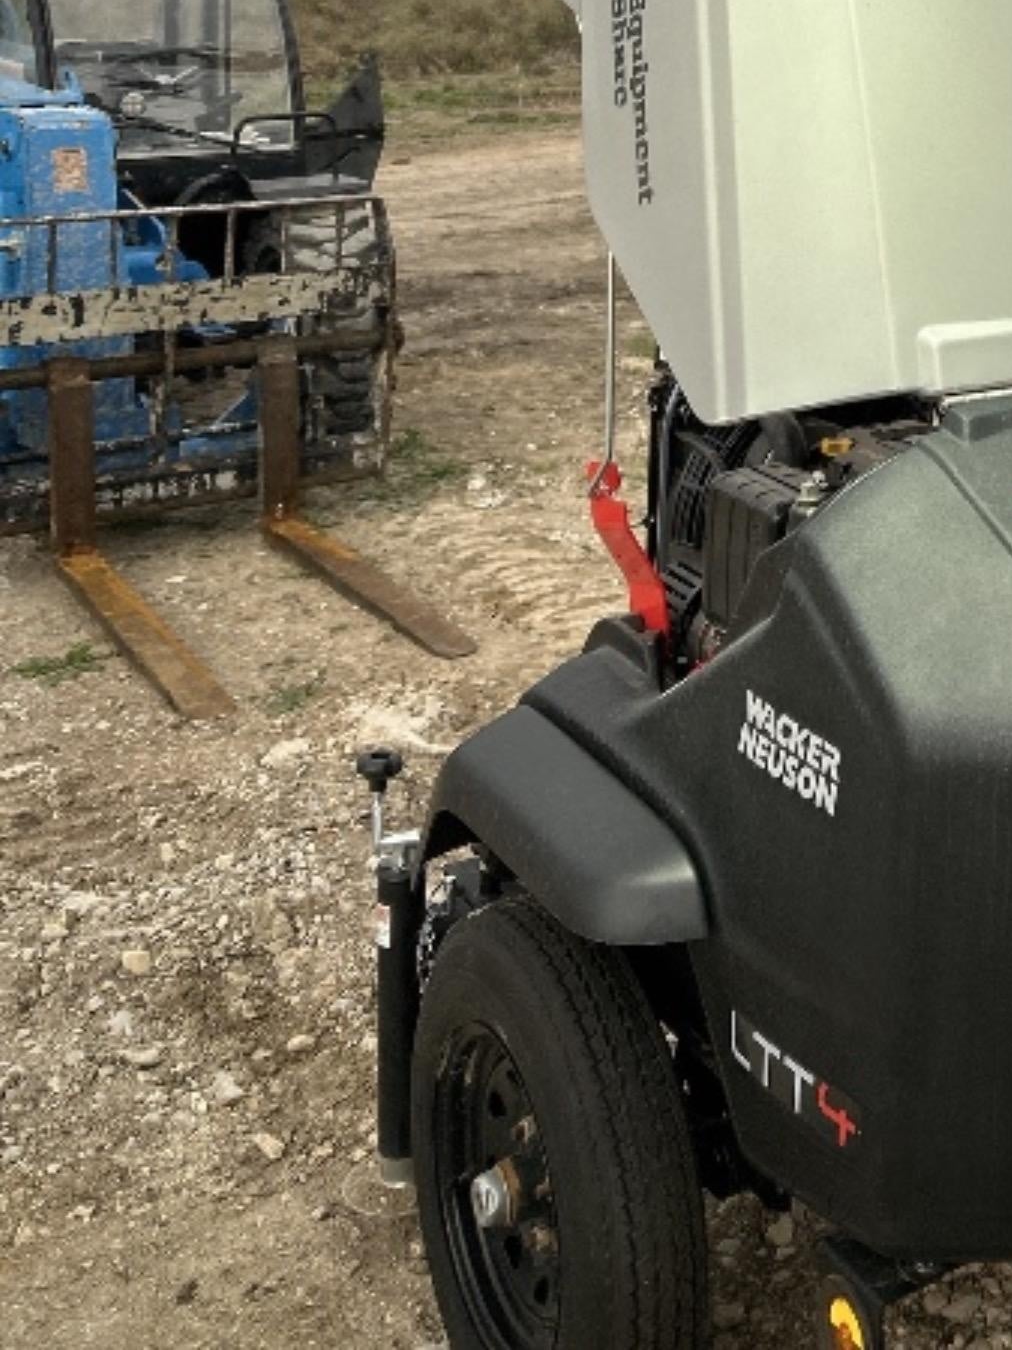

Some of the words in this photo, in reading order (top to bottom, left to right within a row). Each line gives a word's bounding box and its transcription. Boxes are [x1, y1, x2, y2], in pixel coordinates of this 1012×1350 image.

[737, 721, 838, 817] NEUSON
[746, 689, 841, 784] WACKER
[731, 1009, 857, 1147] LTT4
